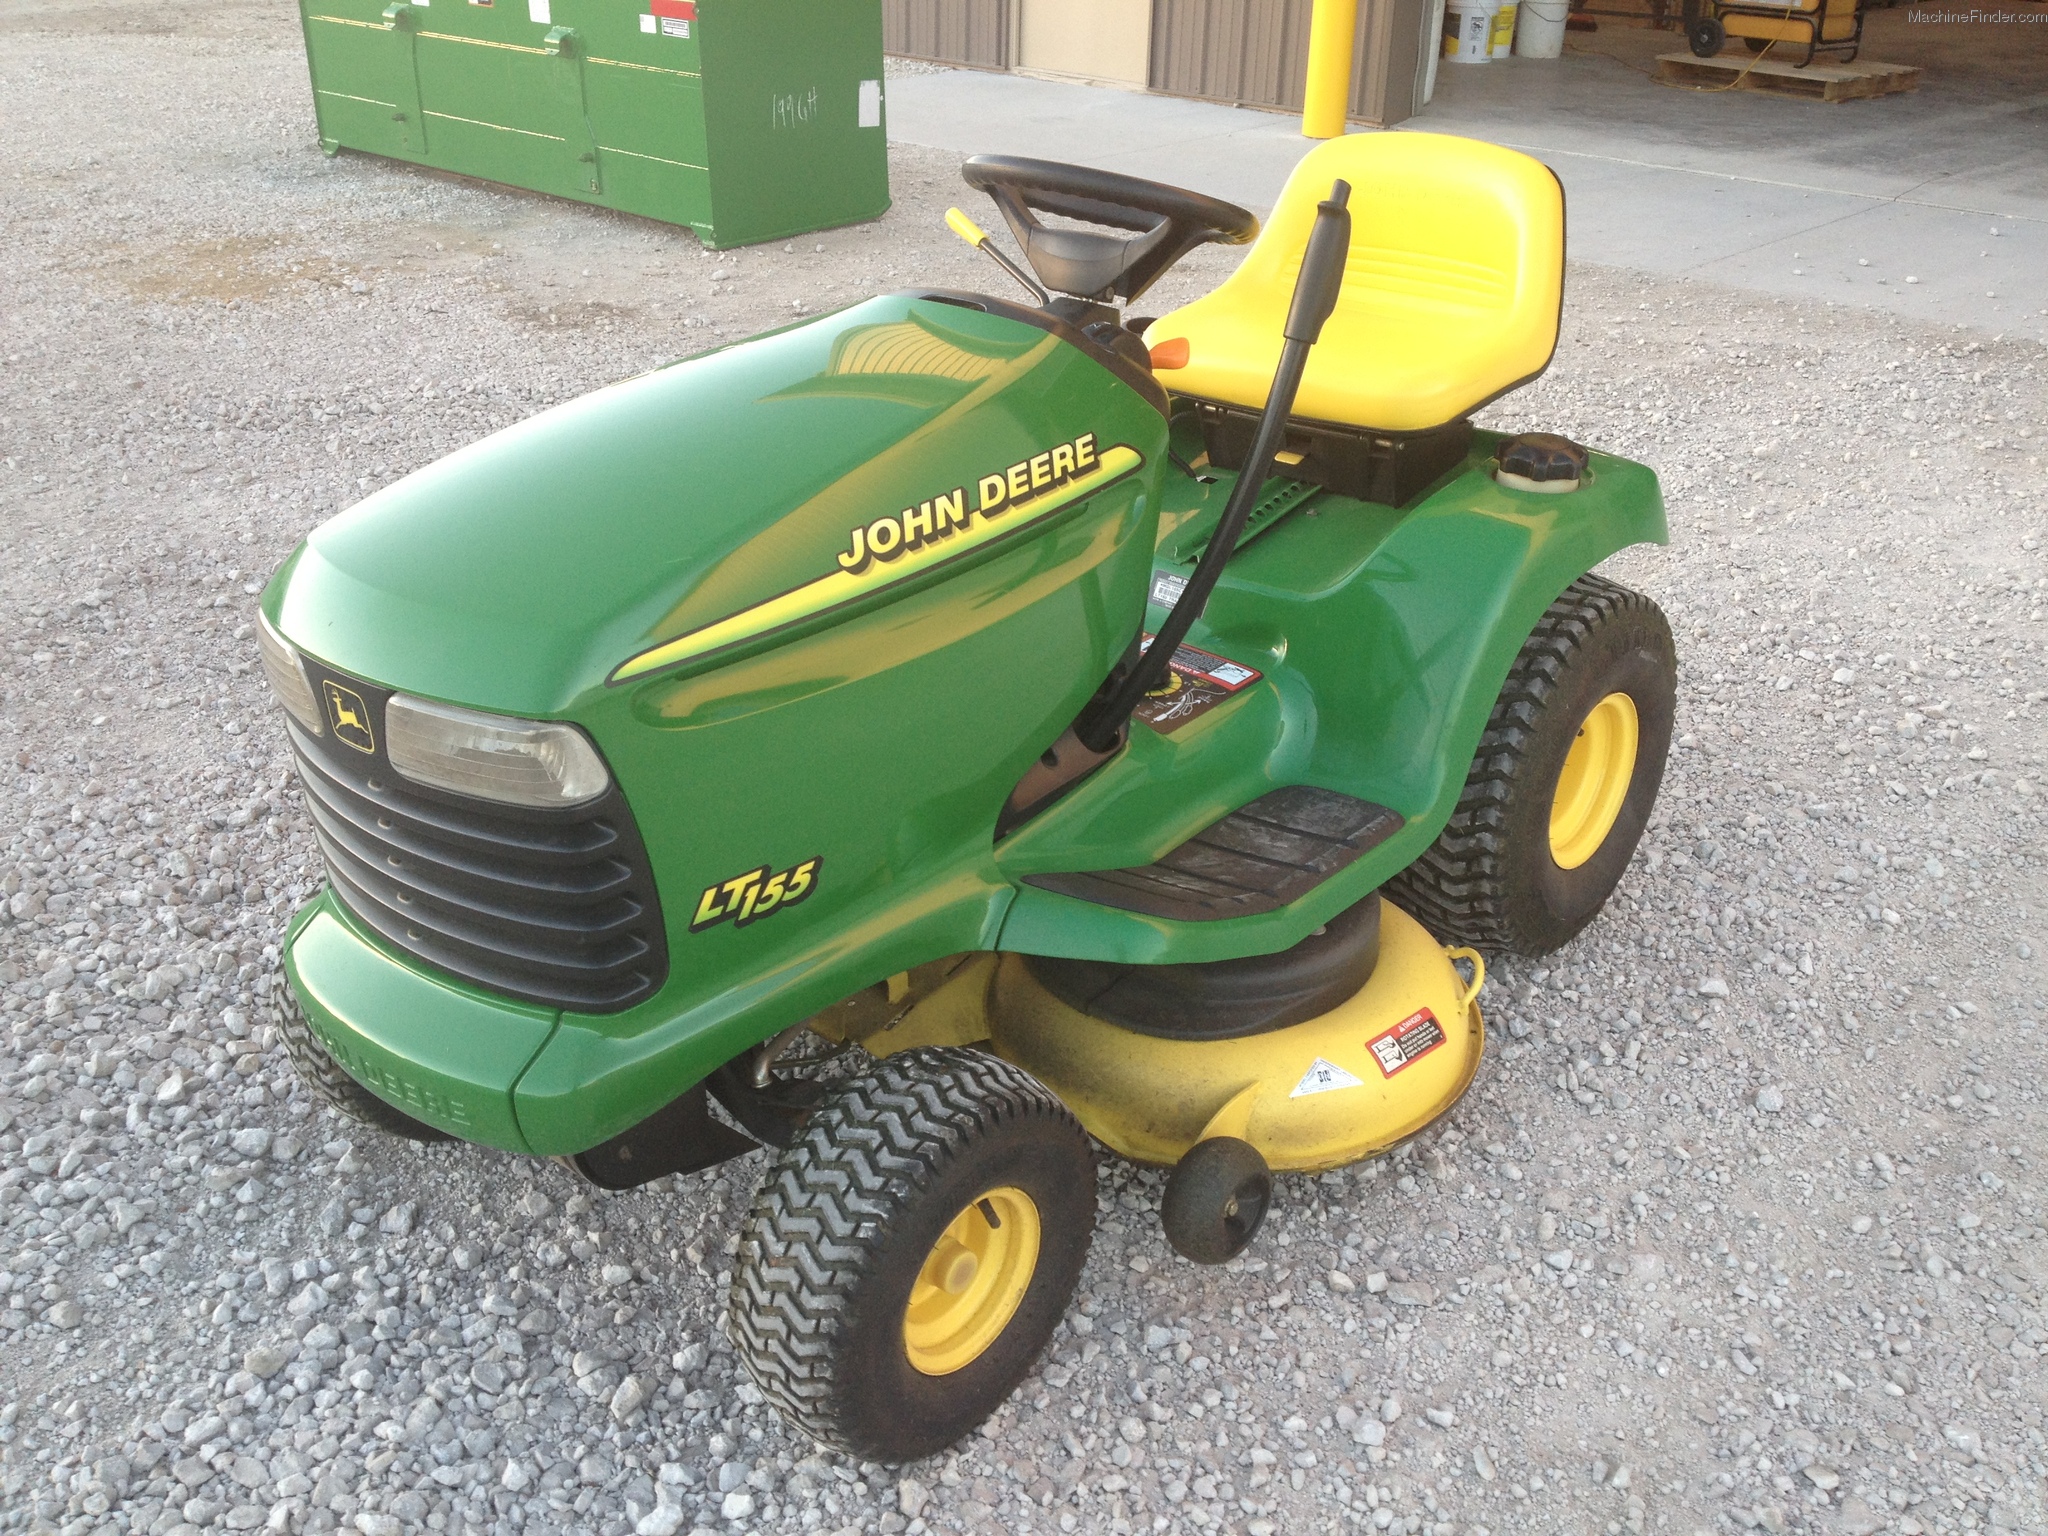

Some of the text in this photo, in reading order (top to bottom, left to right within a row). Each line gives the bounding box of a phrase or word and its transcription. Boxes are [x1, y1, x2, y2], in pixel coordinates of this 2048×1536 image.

[836, 432, 1099, 572] JOHN DEERE
[690, 857, 822, 931] LT155
